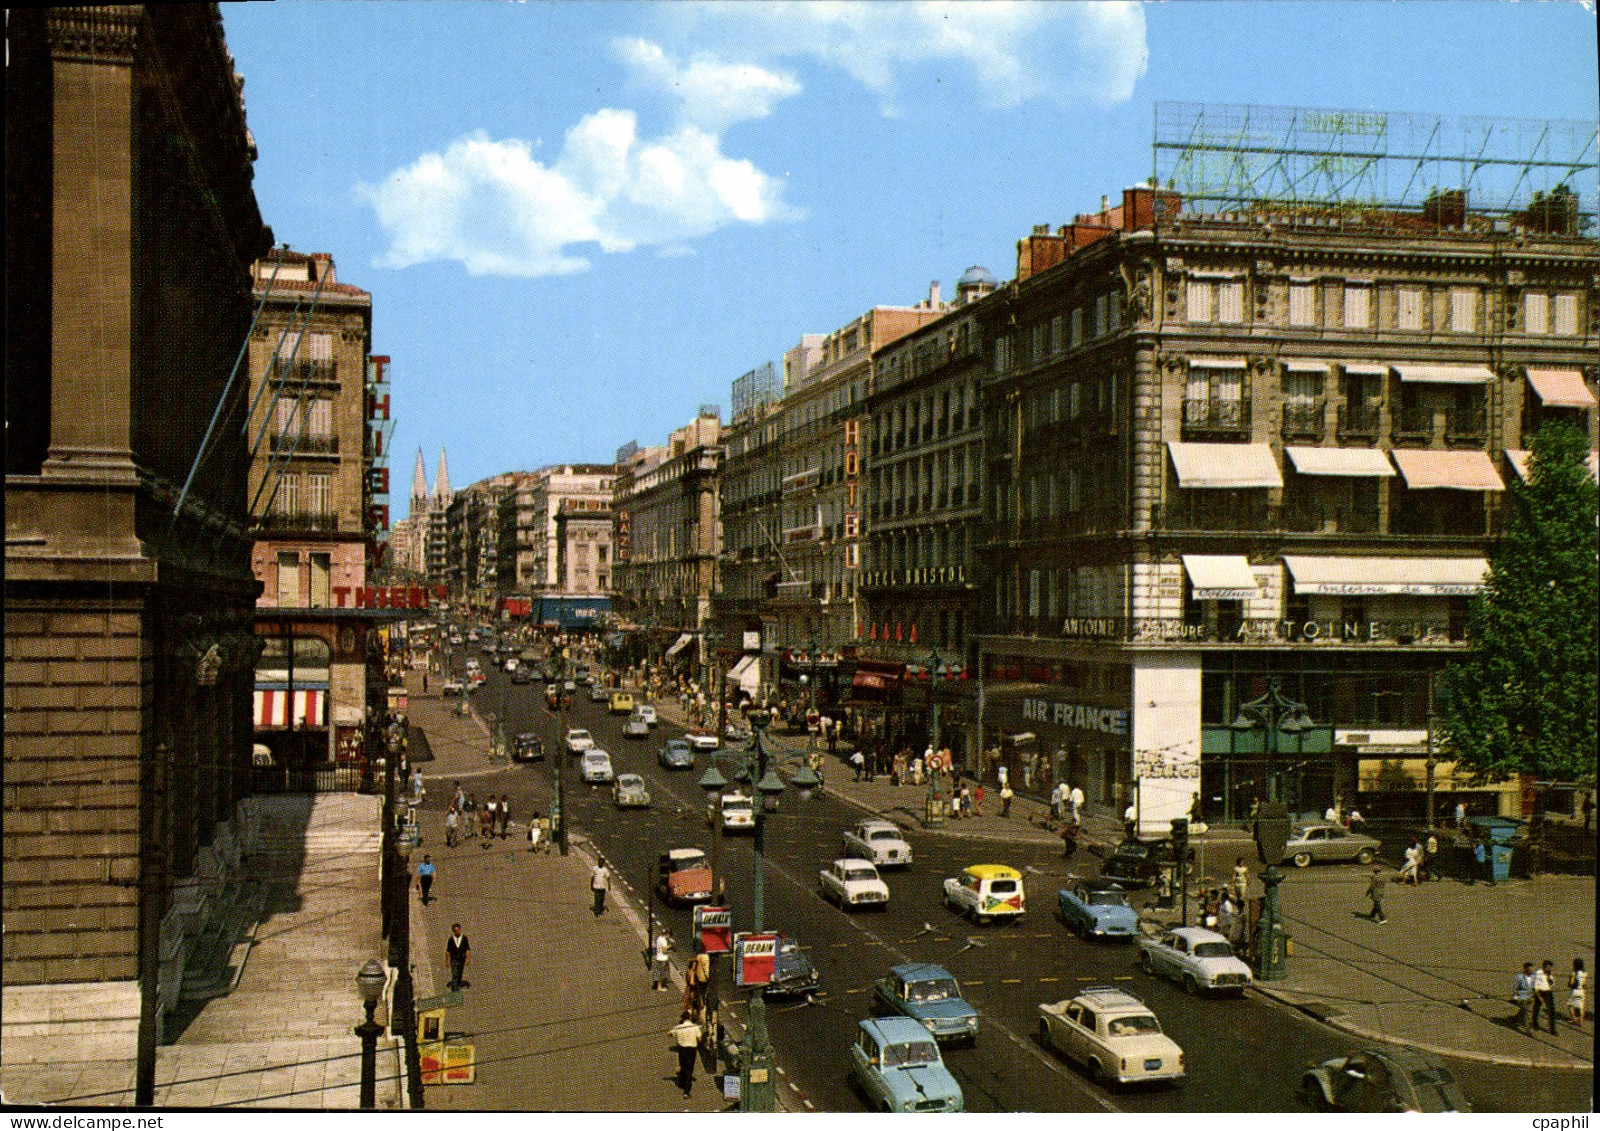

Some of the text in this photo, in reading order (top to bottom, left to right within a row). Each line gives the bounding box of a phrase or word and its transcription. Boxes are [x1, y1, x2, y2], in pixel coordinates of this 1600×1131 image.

[845, 420, 860, 569] HOTEL
[905, 565, 965, 585] BRISTOL
[1236, 620, 1380, 639] ANTOINE
[1022, 698, 1128, 735] AIR FRANCE
